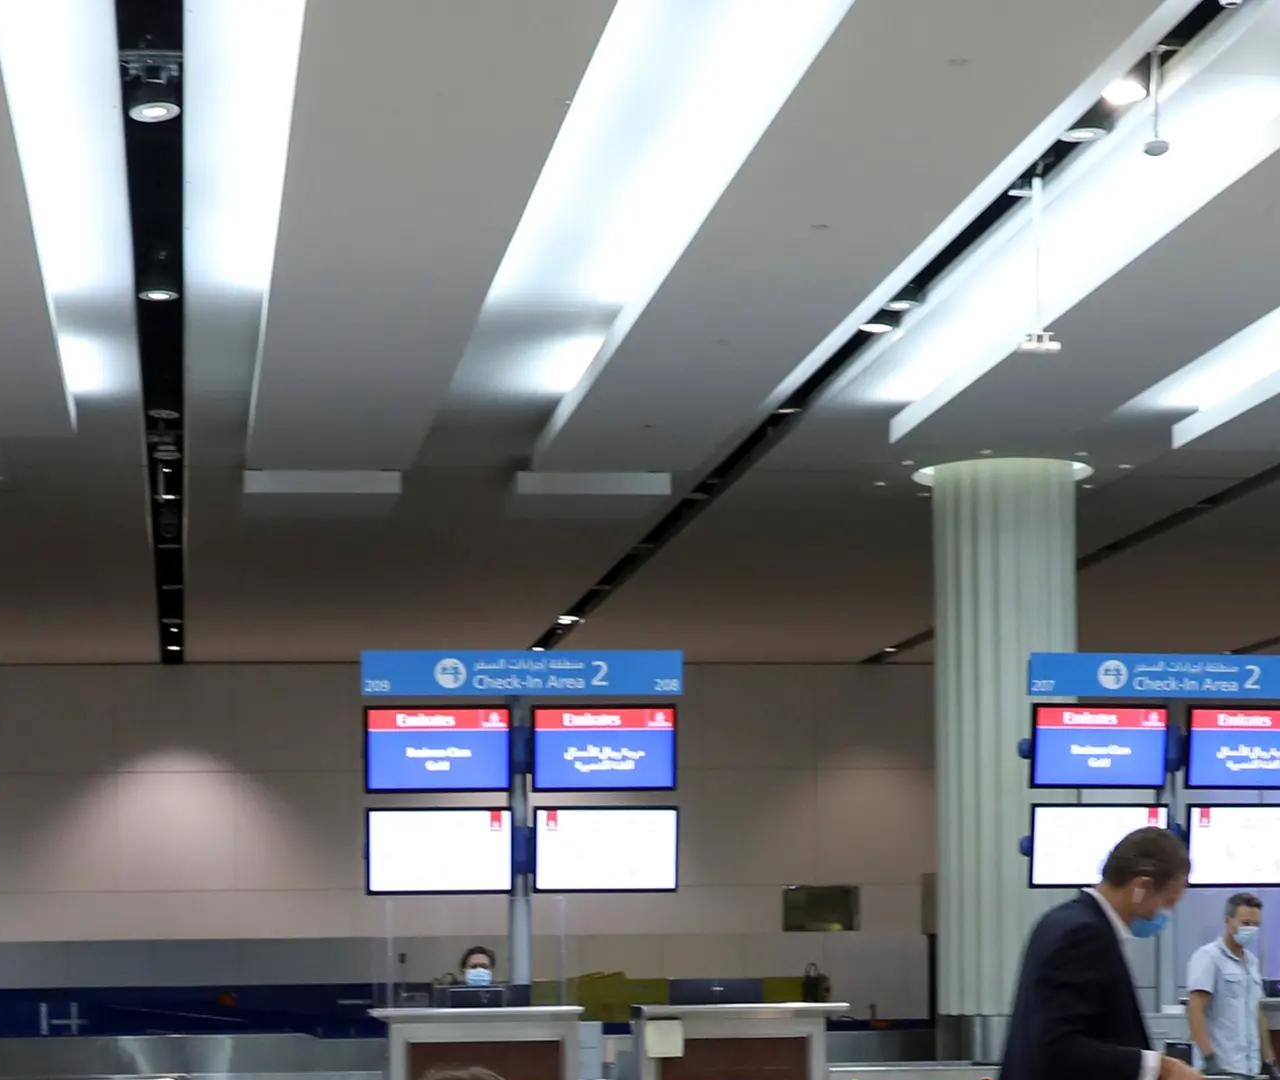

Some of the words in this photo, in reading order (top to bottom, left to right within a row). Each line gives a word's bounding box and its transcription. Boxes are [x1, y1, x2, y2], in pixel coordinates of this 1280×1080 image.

[590, 661, 609, 686] 2
[1243, 666, 1261, 689] 2
[472, 674, 543, 689] Check-In
[545, 675, 586, 689] Area
[1133, 677, 1199, 692] Check-In
[1201, 679, 1239, 692] Area
[396, 712, 456, 726] Emirates
[562, 712, 622, 726] Emirates
[1063, 711, 1118, 725] Emirates
[1217, 713, 1272, 727] Emirates
